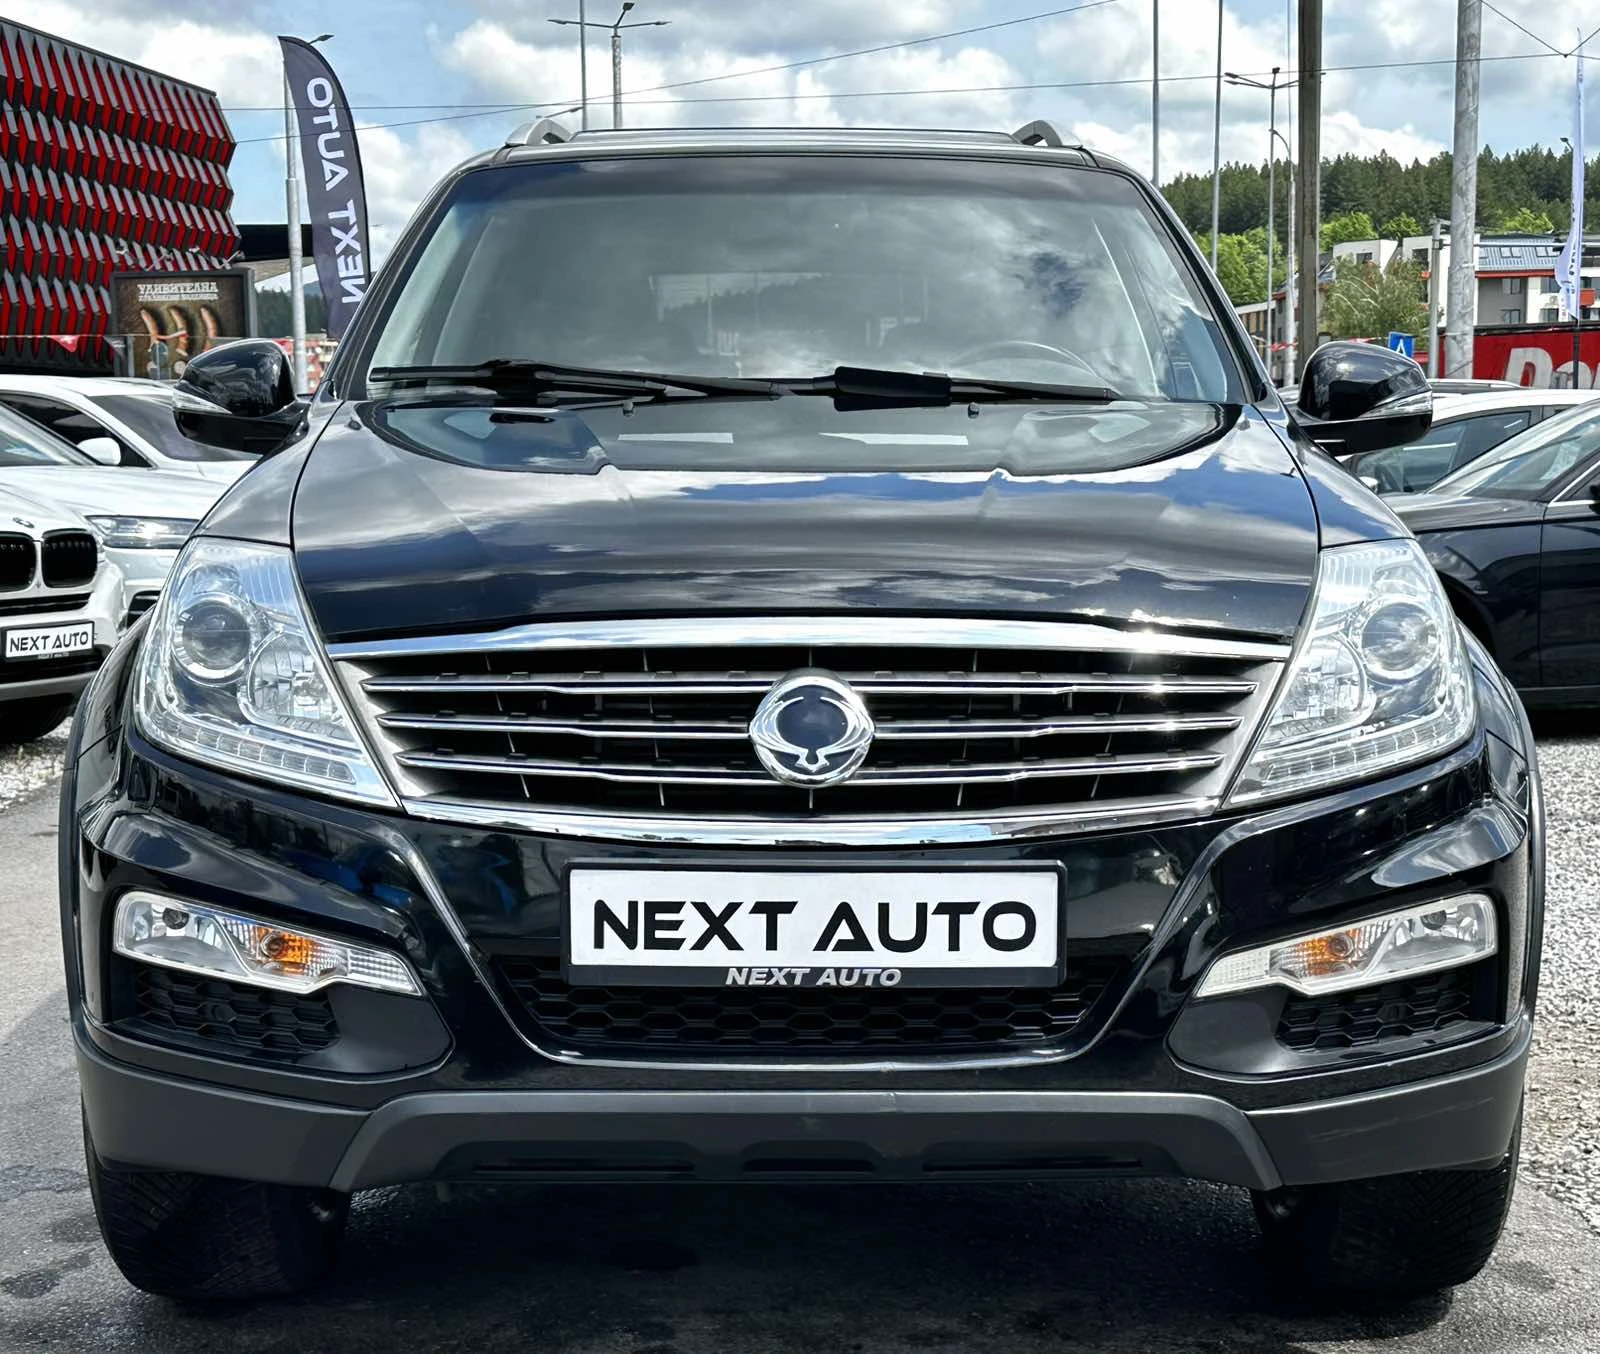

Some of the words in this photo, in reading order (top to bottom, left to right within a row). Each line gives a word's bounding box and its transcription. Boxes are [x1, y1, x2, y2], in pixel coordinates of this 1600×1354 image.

[10, 635, 50, 652] NEXT
[52, 631, 88, 649] AUTO
[594, 900, 797, 951] NEXT
[812, 901, 1036, 952] AUTO
[725, 967, 812, 986] NEXT
[815, 967, 902, 986] AUTO
